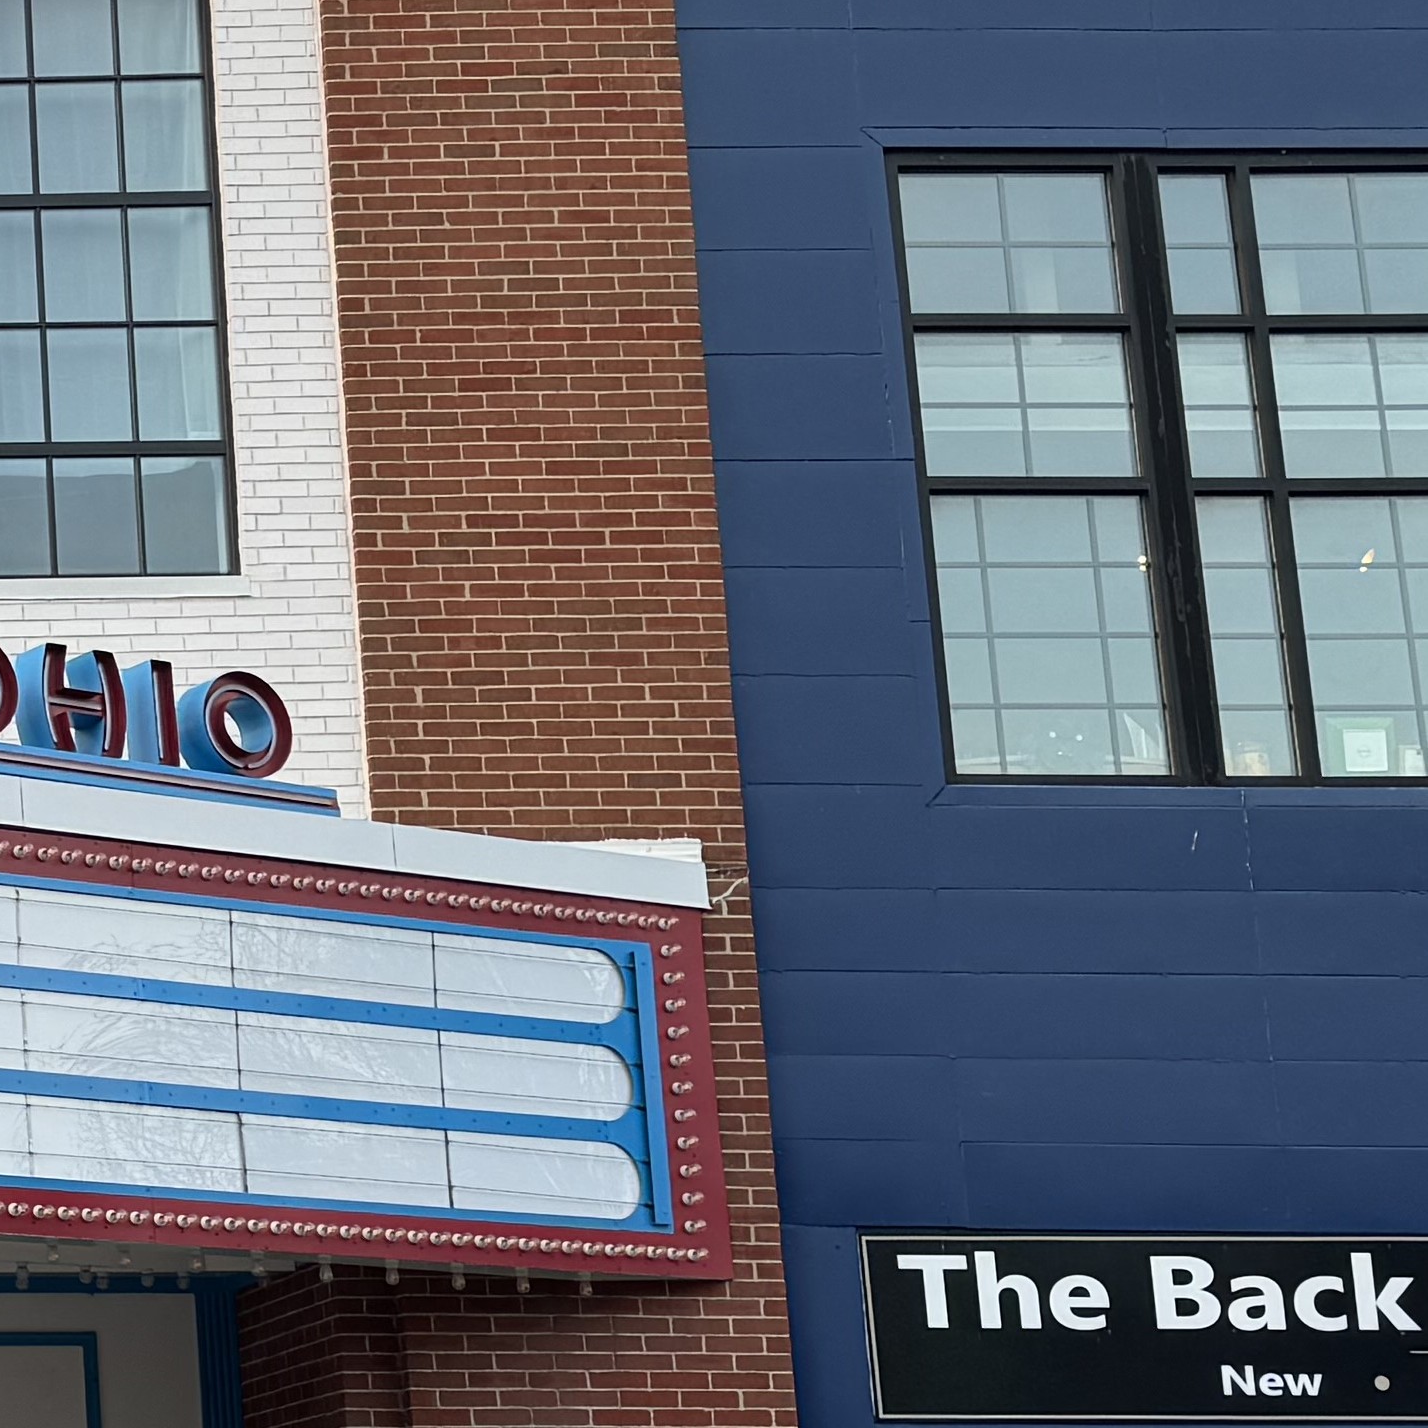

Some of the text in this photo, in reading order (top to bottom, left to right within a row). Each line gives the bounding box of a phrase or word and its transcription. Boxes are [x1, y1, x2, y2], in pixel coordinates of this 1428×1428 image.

[896, 1251, 1422, 1332] The Back
[1221, 1365, 1322, 1397] New
